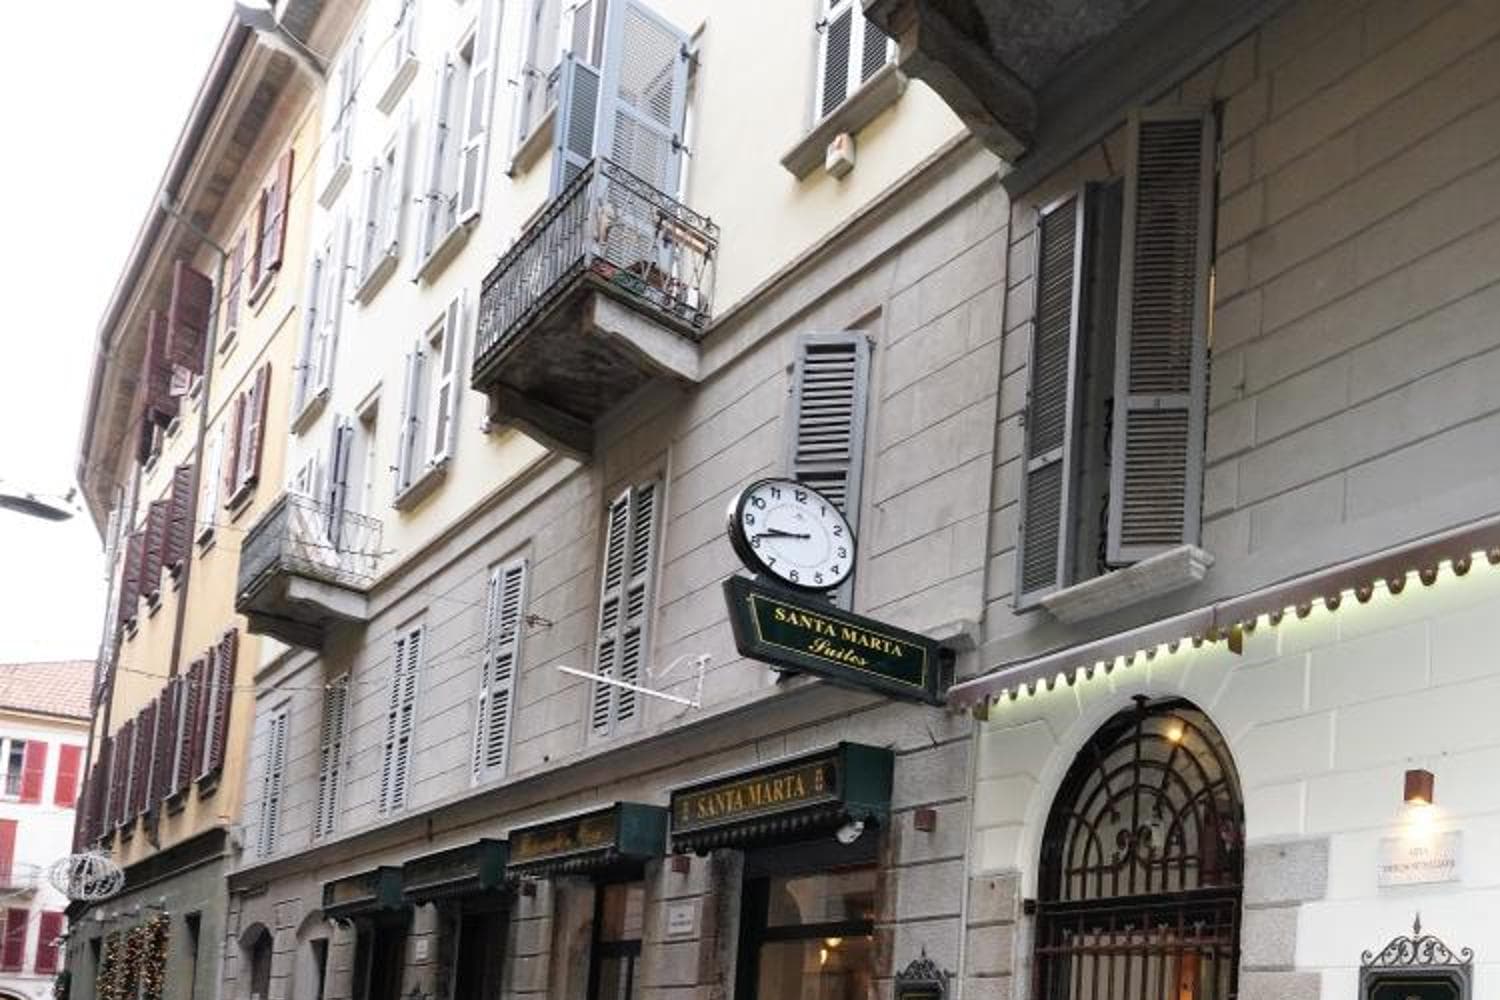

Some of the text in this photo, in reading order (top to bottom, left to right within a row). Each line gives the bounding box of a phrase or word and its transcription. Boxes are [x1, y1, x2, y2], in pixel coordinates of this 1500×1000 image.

[771, 486, 781, 500] 11
[794, 488, 809, 505] 12
[751, 496, 767, 511] 10
[820, 506, 826, 517] 1
[745, 513, 756, 526] 9
[832, 524, 843, 536] 2
[837, 547, 847, 559] 3
[767, 556, 777, 567] 7
[789, 569, 800, 584] 6
[830, 565, 840, 576] 4
[813, 572, 823, 585] 5
[773, 606, 903, 658] SANTA MARTA
[807, 637, 868, 667] Suites
[696, 774, 806, 819] SANTA MARTA
